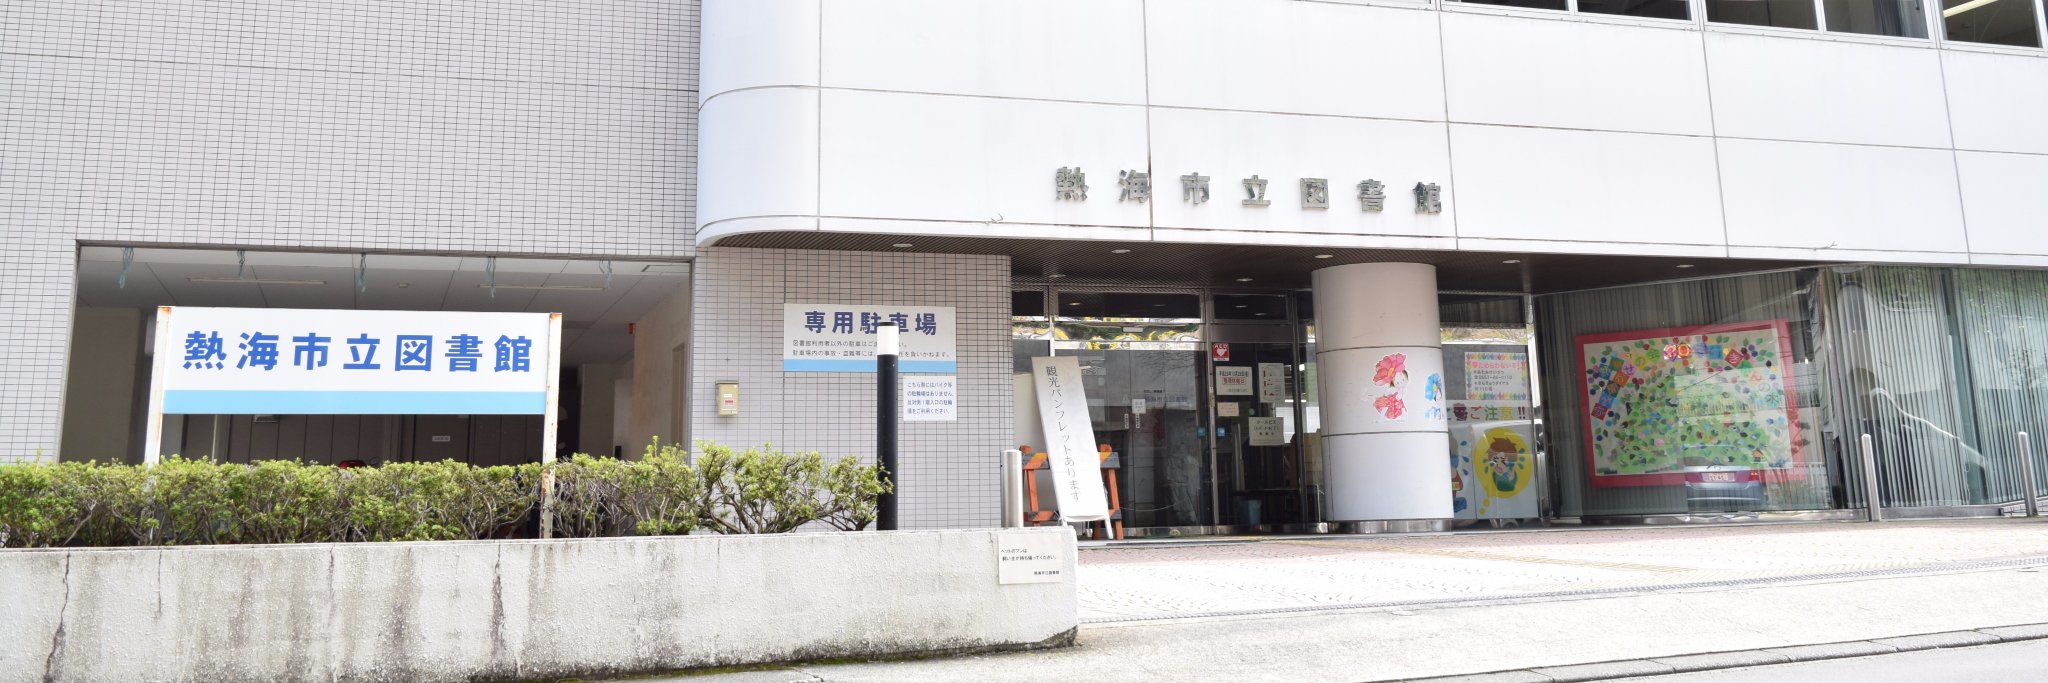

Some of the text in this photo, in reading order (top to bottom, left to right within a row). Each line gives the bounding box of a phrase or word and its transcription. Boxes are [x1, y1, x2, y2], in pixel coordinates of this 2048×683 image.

[1055, 166, 1442, 214] 熱海市立図書館
[804, 310, 937, 335] 専用駐車場
[182, 331, 533, 373] 熱海市立図書館
[1046, 366, 1081, 502] 観光パンフレットあります
